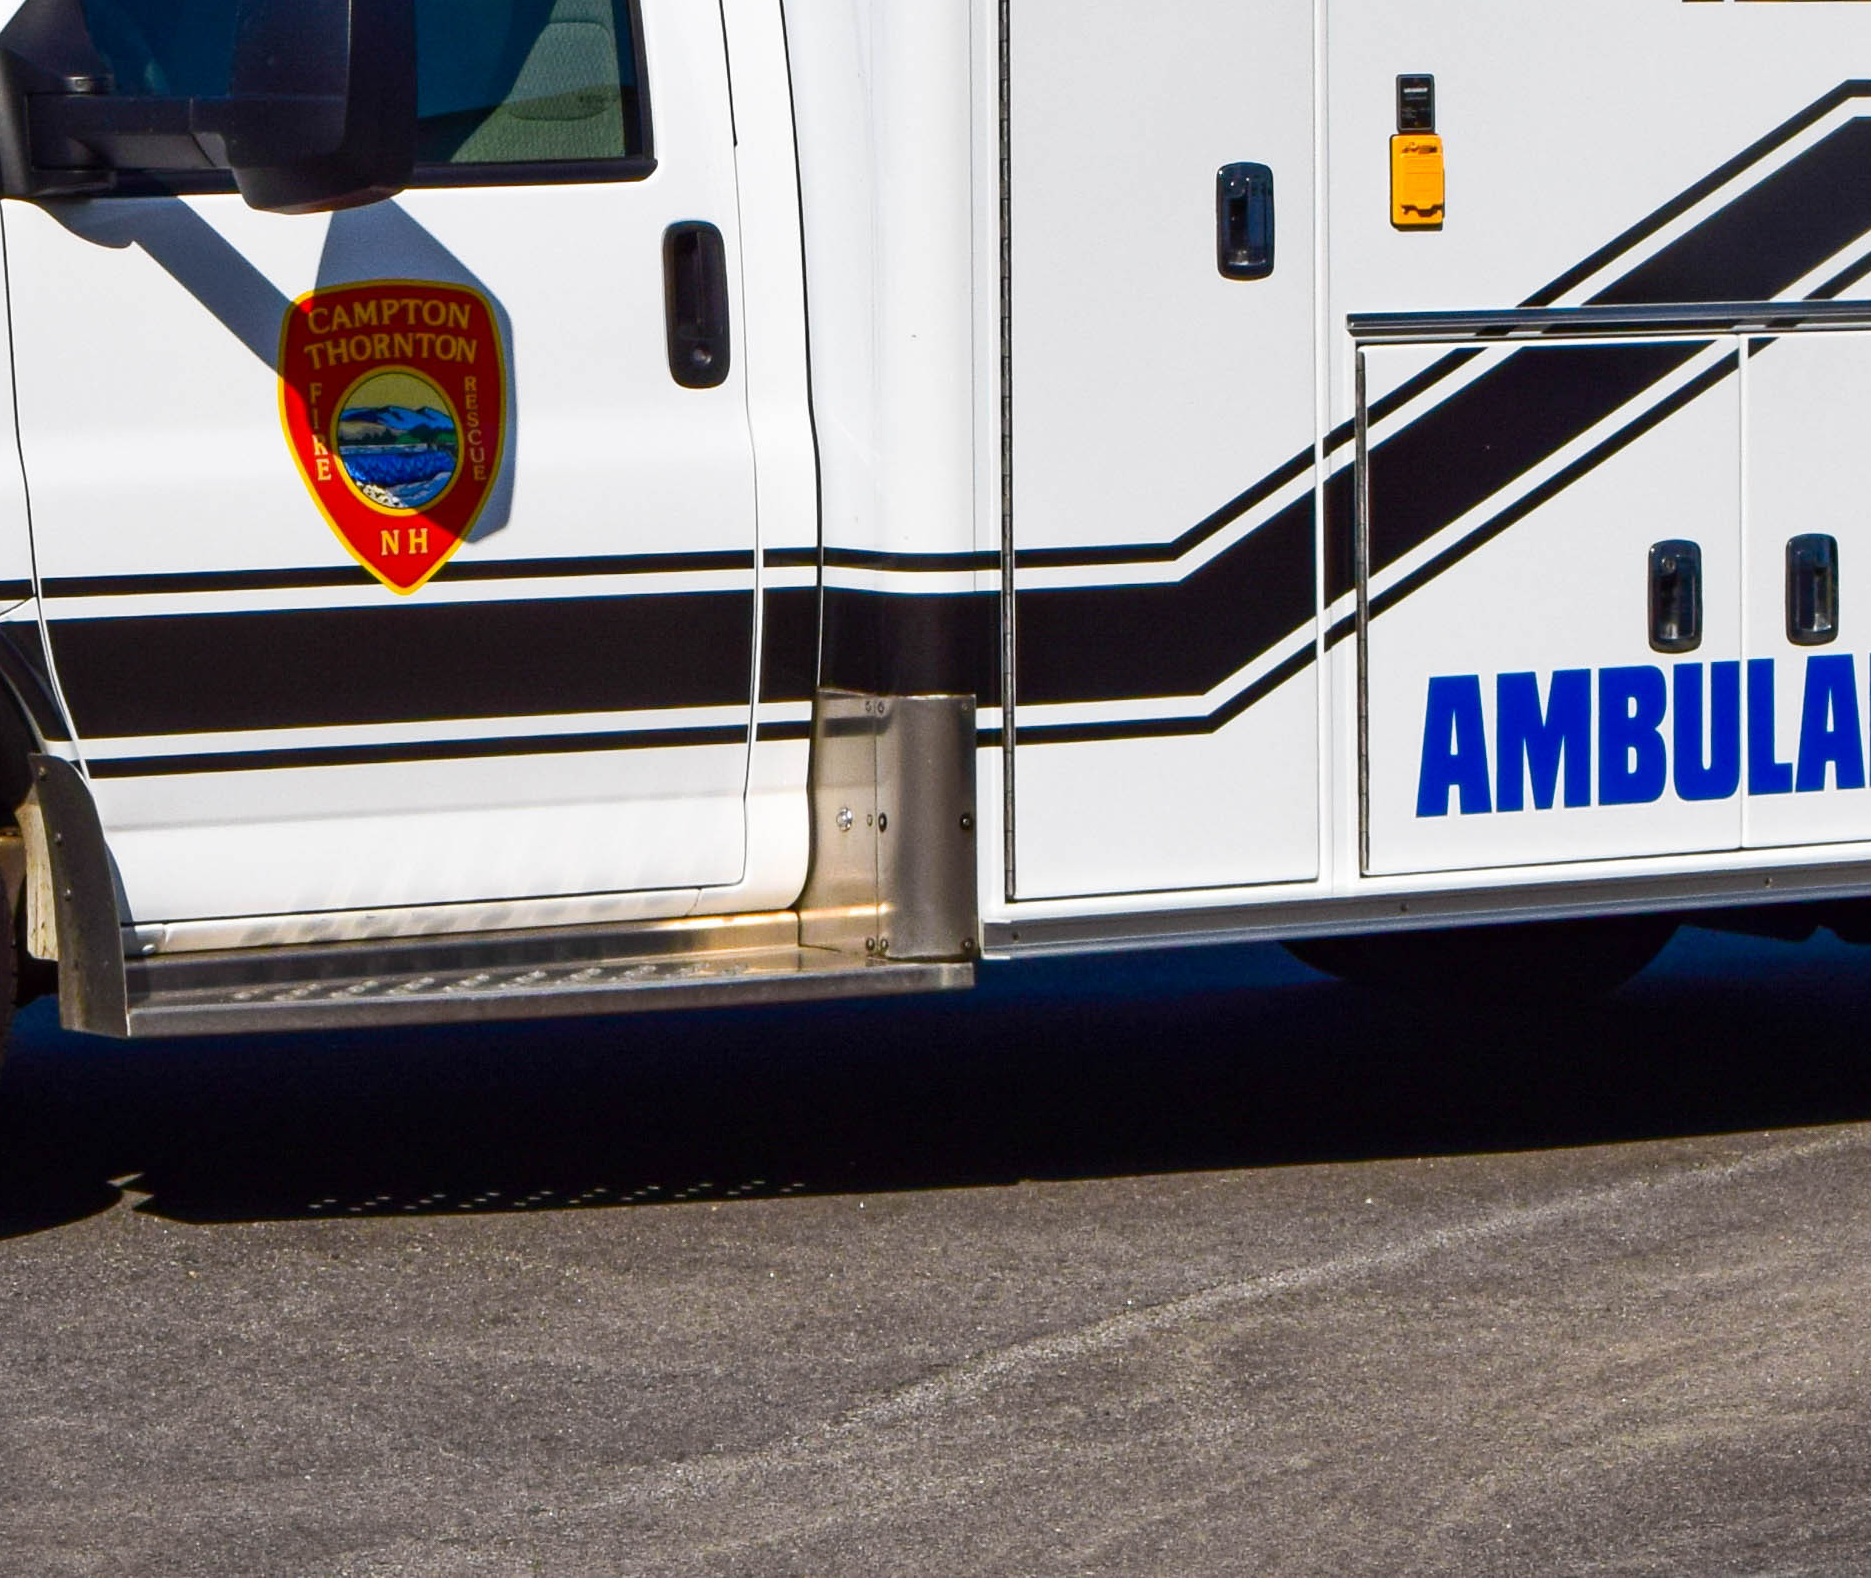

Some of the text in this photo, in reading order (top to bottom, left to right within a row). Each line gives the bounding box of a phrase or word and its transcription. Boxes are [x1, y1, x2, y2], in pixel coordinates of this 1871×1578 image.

[307, 297, 472, 335] CAMPTON
[303, 332, 478, 371] THORNTON
[308, 382, 333, 481] FIRE
[463, 375, 488, 482] RESCUE
